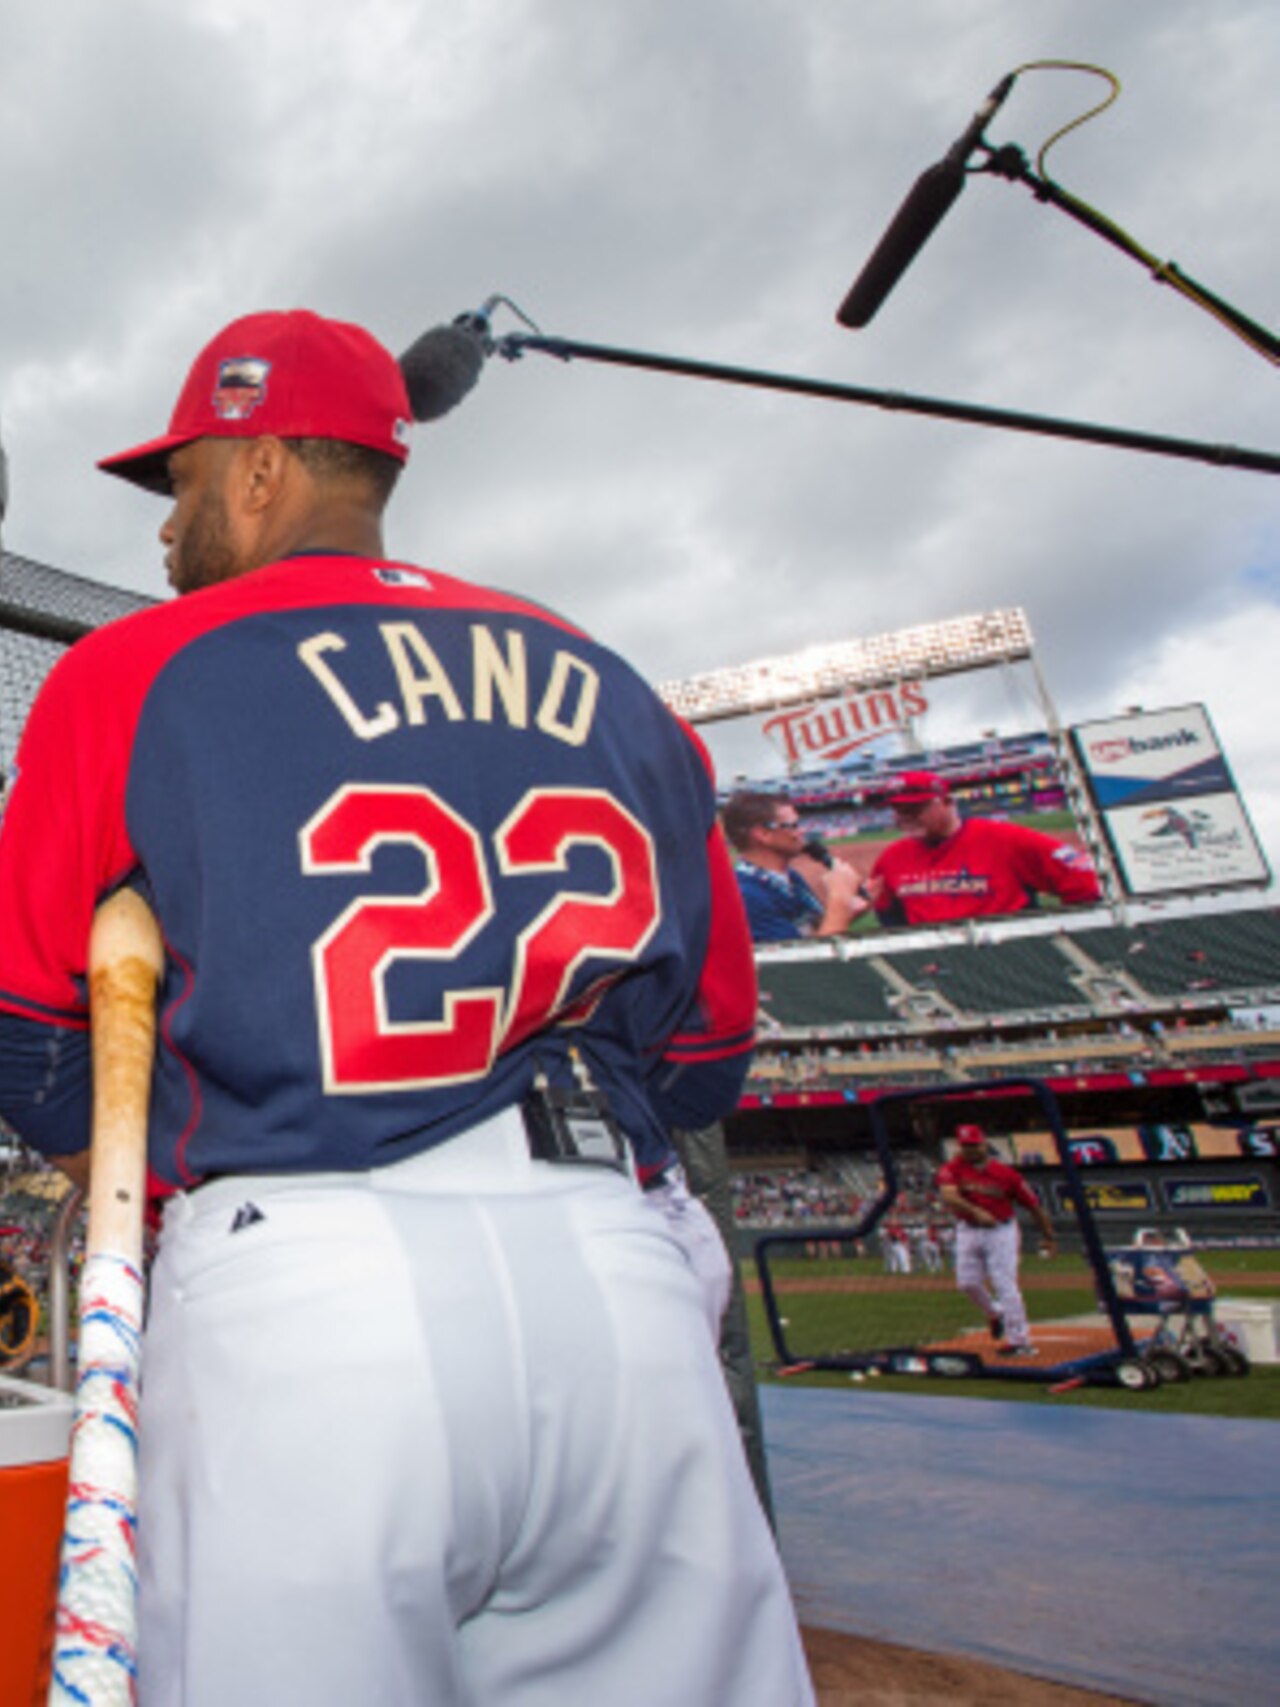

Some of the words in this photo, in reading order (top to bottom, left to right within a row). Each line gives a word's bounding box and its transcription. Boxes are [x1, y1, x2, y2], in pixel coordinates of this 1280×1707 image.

[296, 622, 599, 746] CANO
[762, 681, 928, 761] Twins
[298, 783, 661, 1095] 22
[1172, 1183, 1261, 1203] SUBWAY
